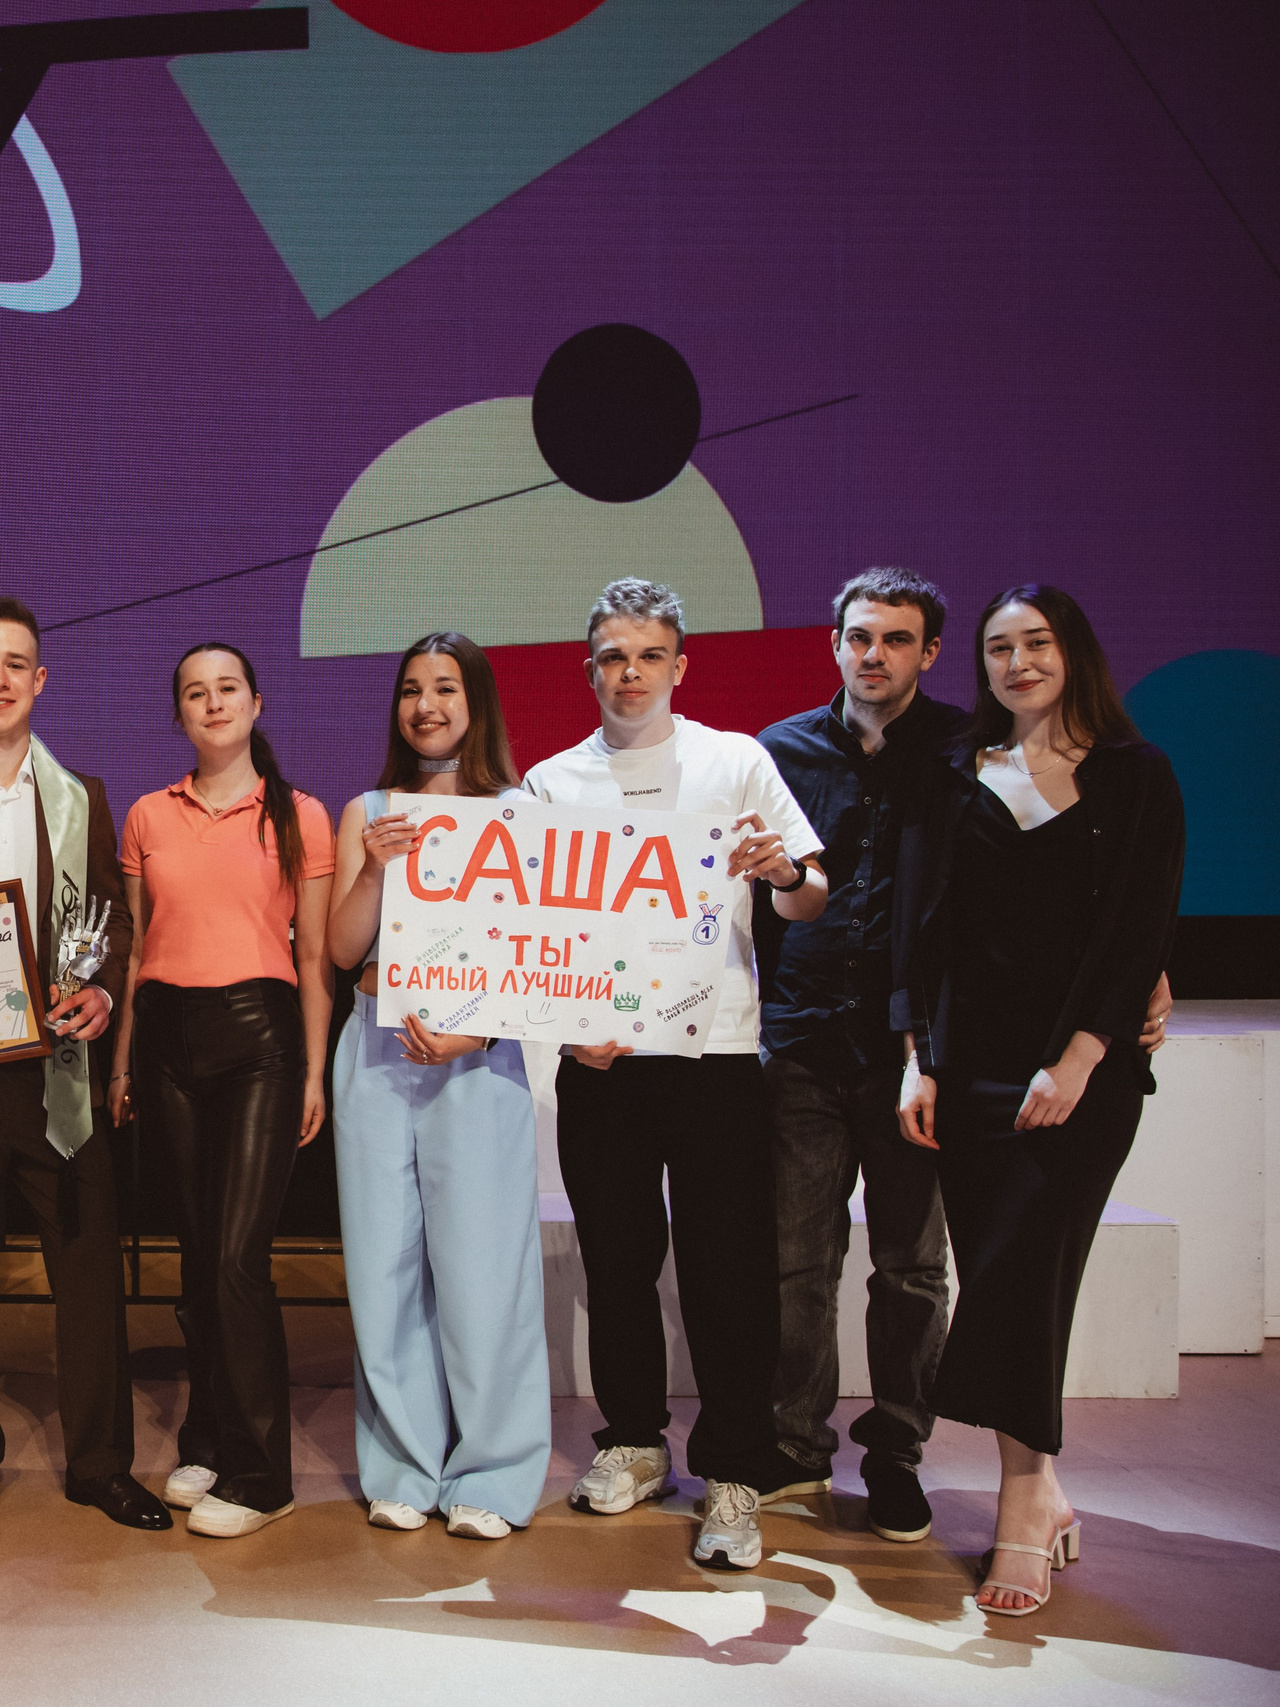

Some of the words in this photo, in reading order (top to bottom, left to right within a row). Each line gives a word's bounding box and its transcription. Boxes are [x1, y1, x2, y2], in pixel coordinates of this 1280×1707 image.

[623, 787, 662, 796] WOHLHABEND
[406, 815, 688, 919] САША
[508, 934, 571, 967] ТЫ
[387, 963, 487, 991] САМЫЙ
[499, 970, 614, 1000] ЛУЧШИЙ
